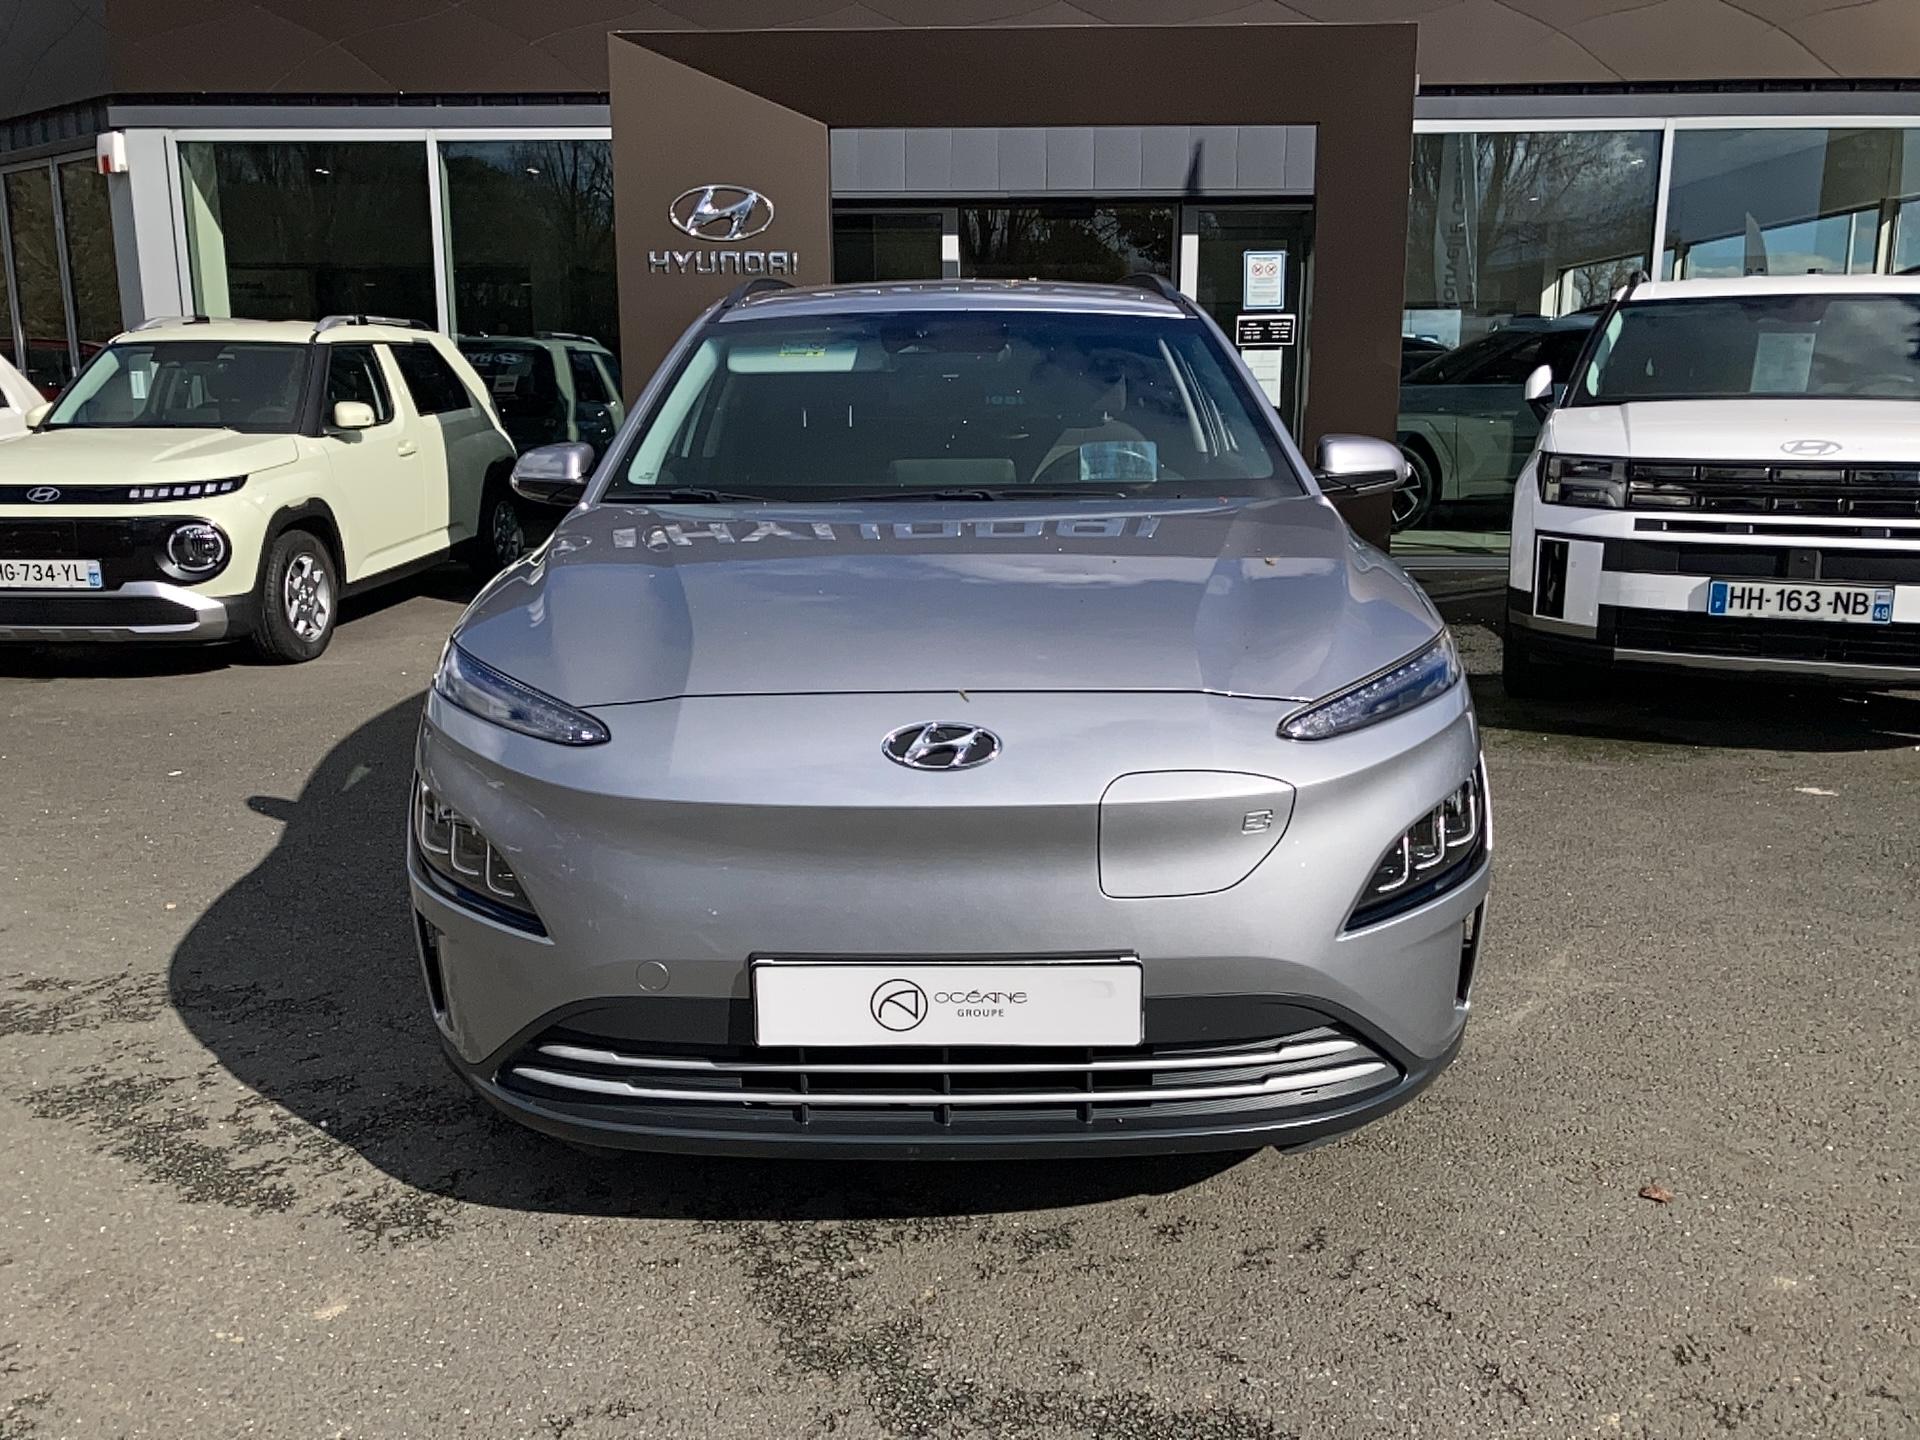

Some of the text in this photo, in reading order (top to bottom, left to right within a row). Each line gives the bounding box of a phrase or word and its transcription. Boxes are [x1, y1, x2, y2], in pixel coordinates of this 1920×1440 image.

[648, 250, 799, 274] HYUNDAI
[934, 989, 1028, 1004] OCÉANE
[956, 1008, 1005, 1018] GROUPE
